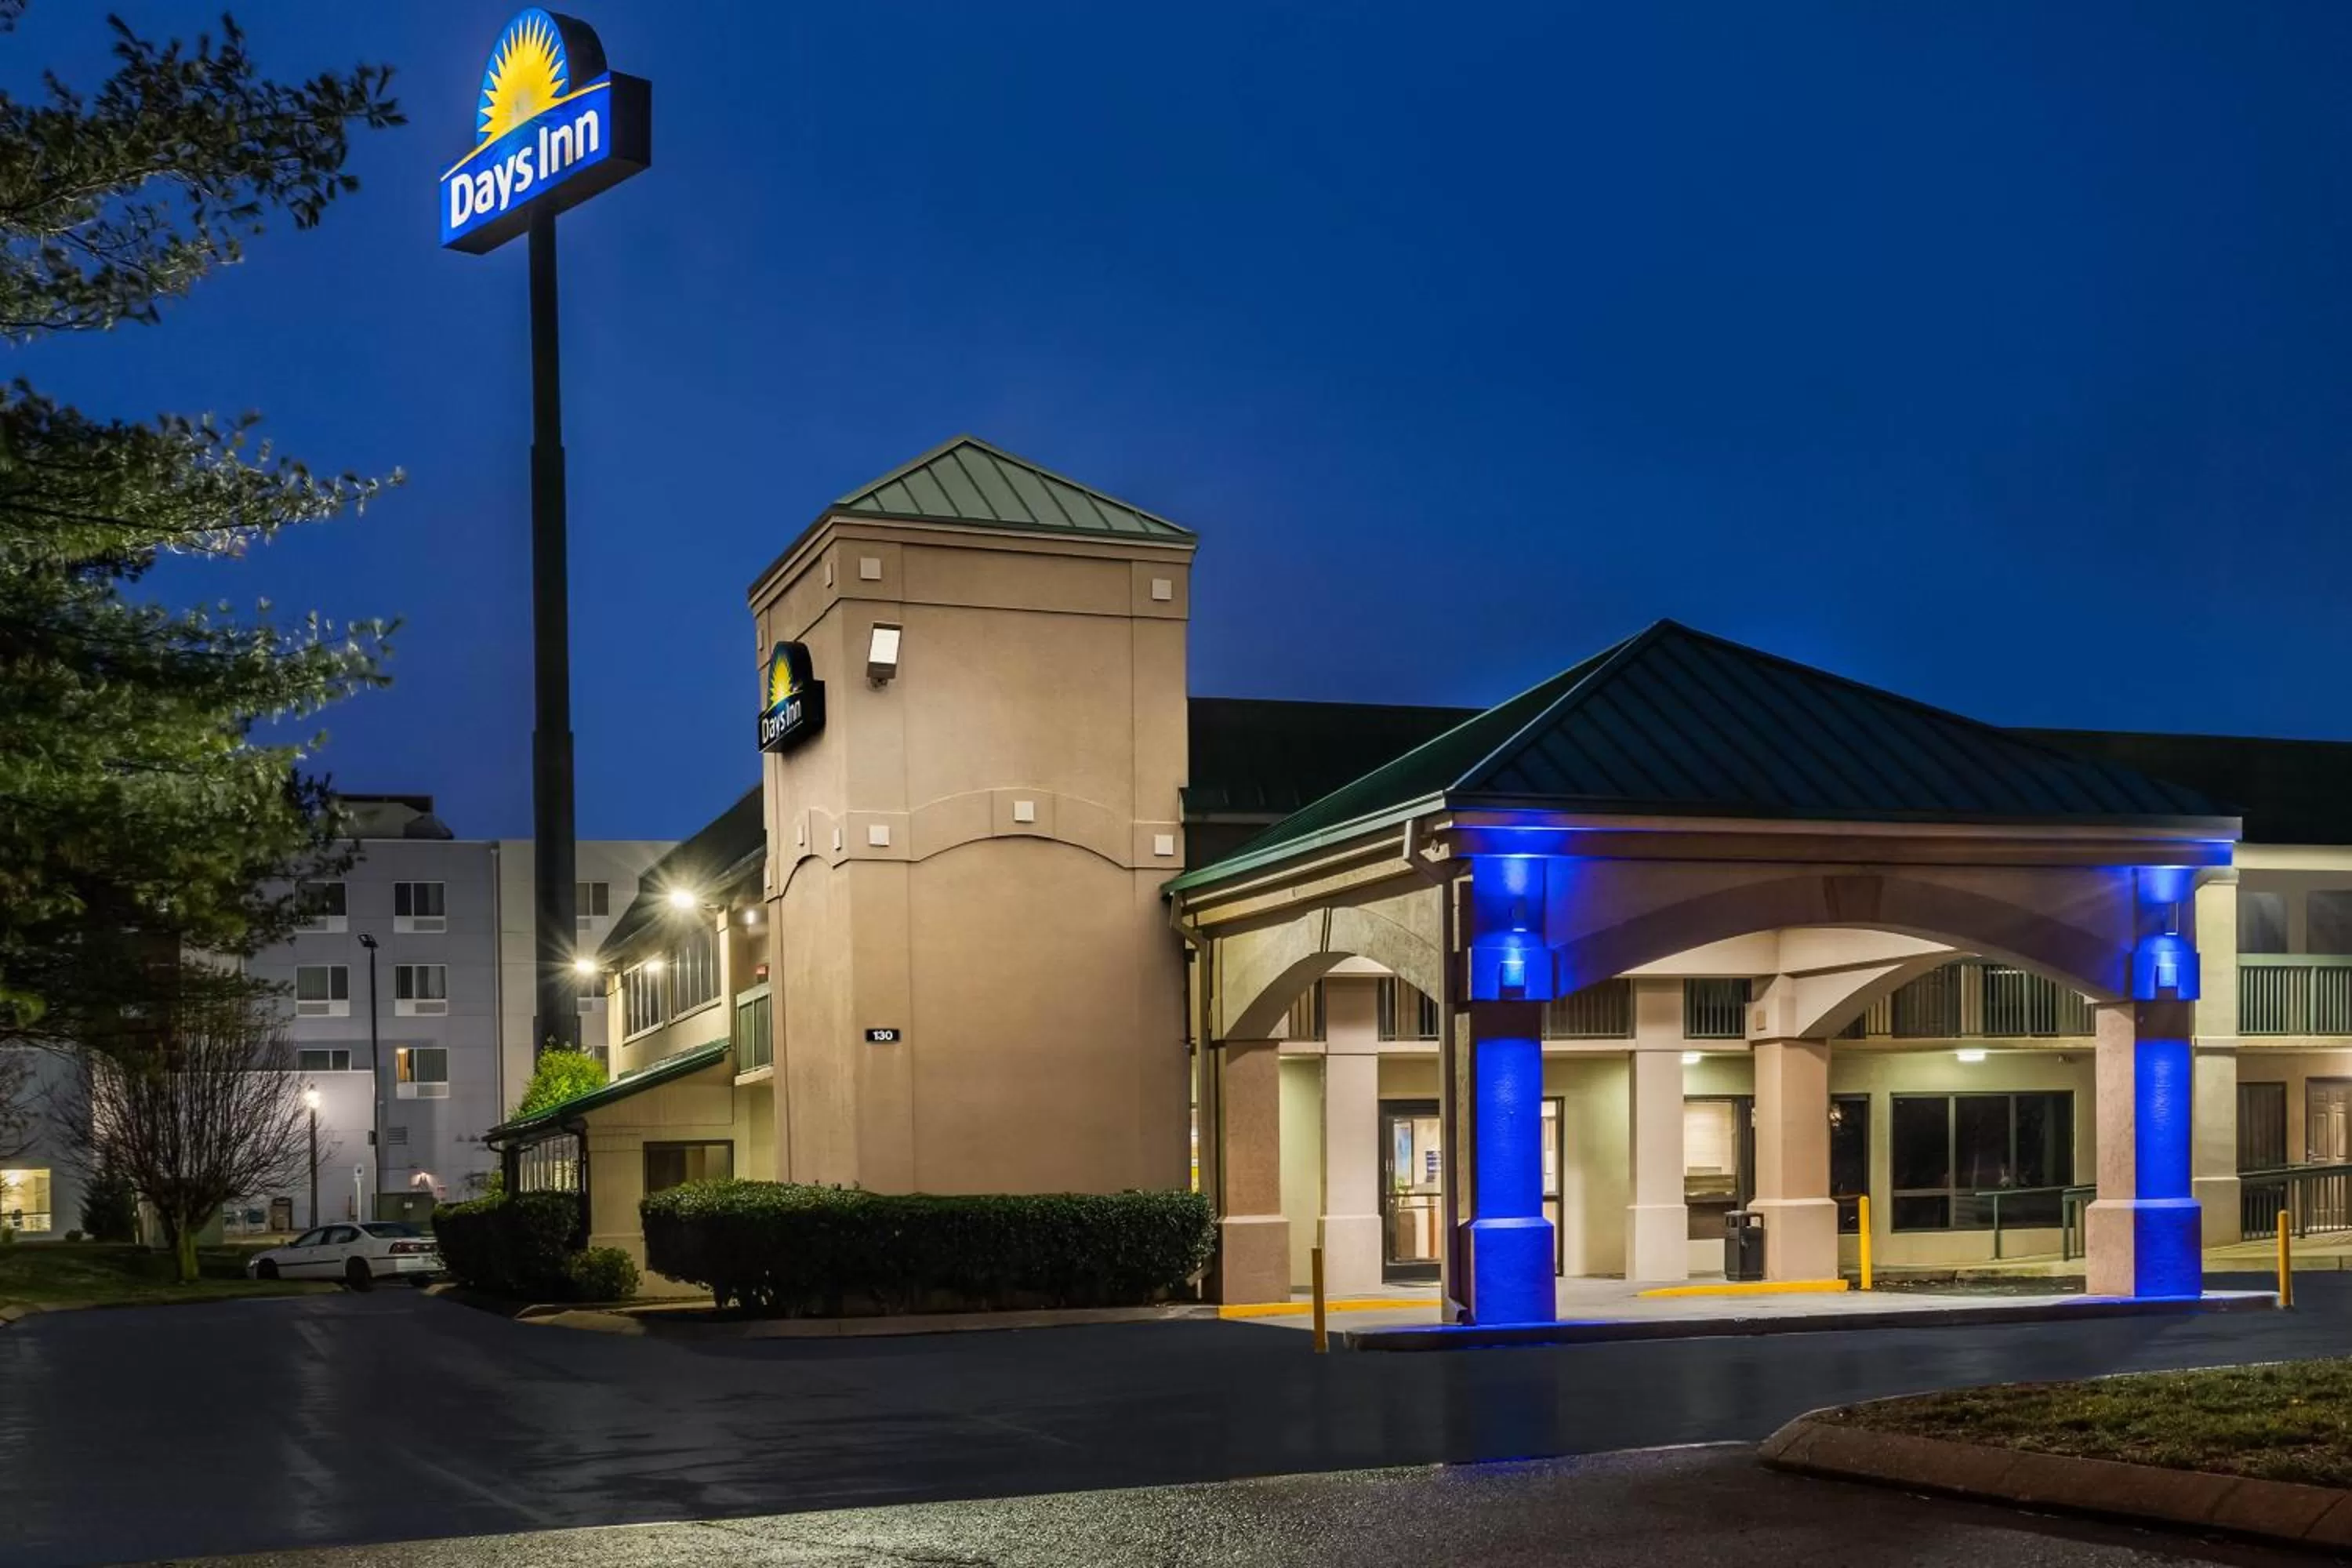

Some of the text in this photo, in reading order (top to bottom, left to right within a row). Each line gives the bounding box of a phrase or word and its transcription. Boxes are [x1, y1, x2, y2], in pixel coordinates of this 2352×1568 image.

[451, 110, 599, 229] Days Inn
[761, 700, 801, 743] Days Inn
[873, 1030, 893, 1040] 130
